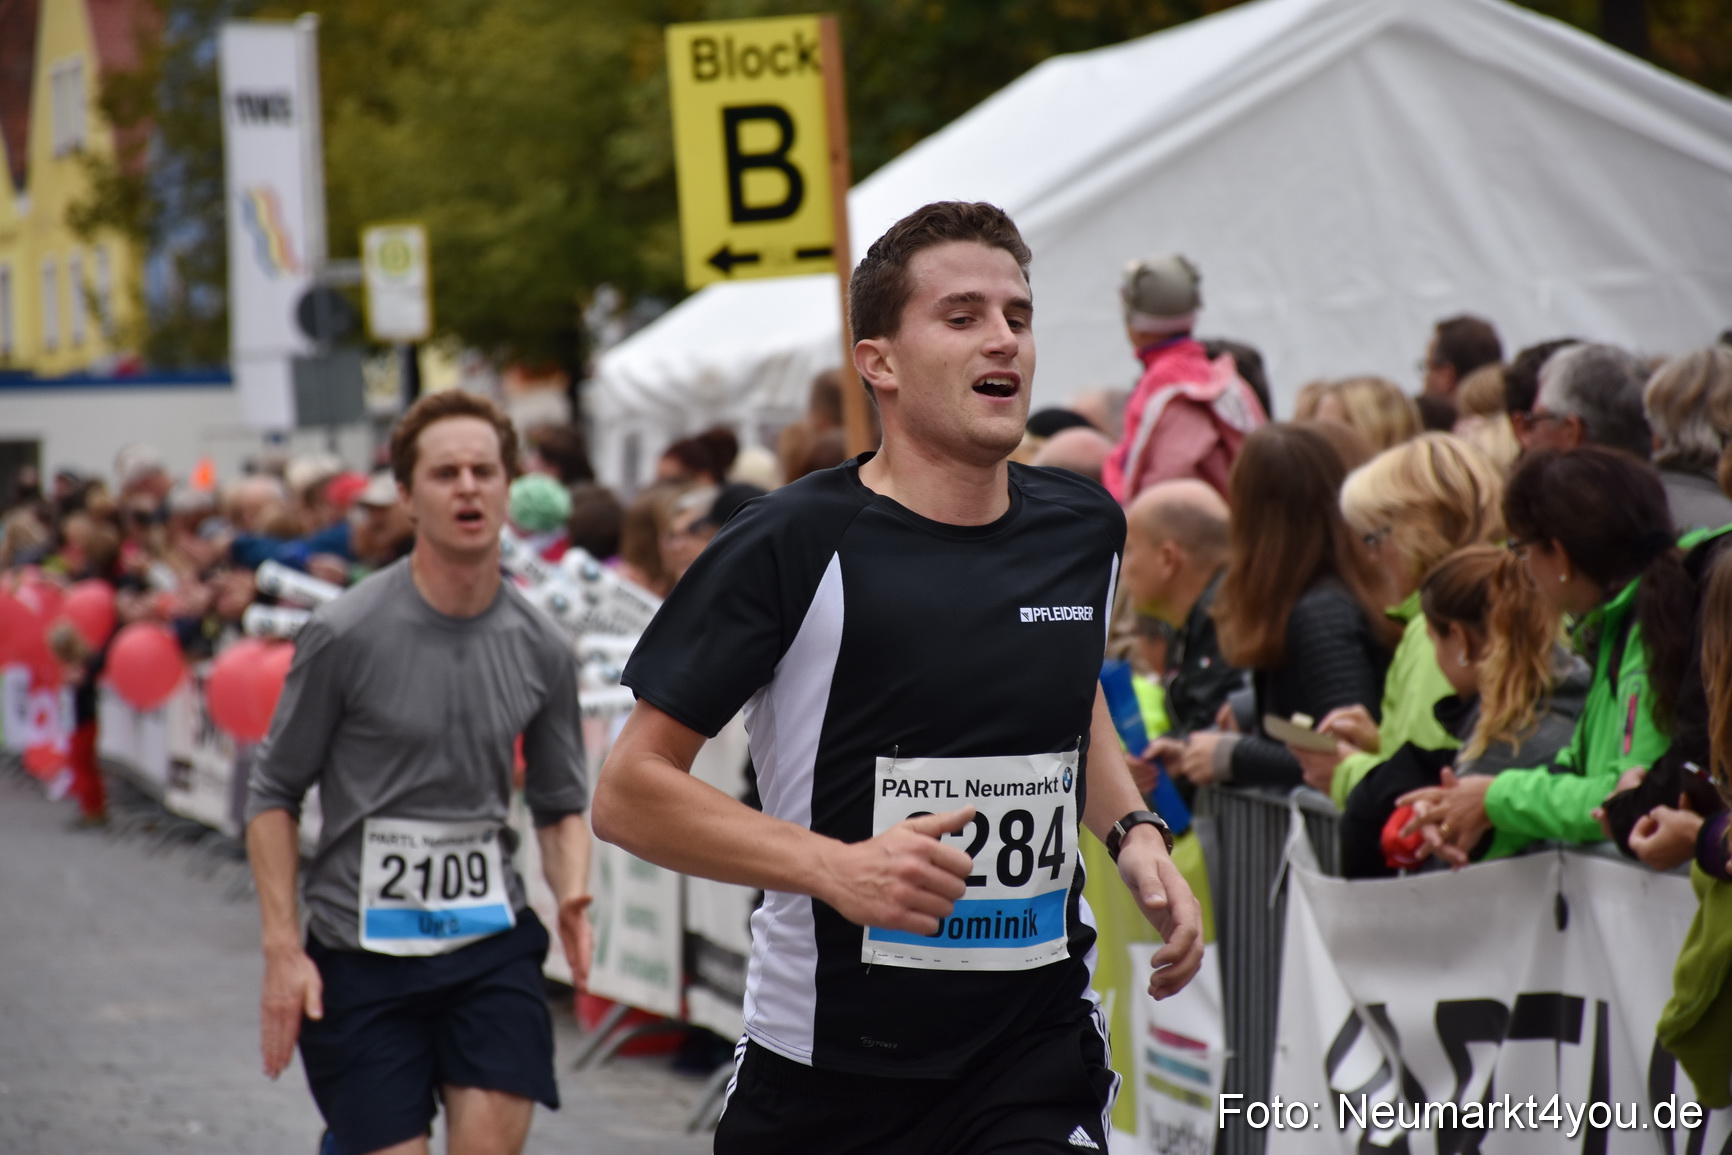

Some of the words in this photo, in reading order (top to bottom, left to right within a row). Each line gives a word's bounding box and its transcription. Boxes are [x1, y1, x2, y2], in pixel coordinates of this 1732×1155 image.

[692, 33, 823, 82] Block
[722, 103, 806, 224] B
[1033, 606, 1094, 622] PFLEIDERER
[882, 778, 959, 799] PARTL
[965, 777, 1058, 798] Neumarkt
[905, 805, 1066, 888] 284
[380, 851, 488, 901] 2109
